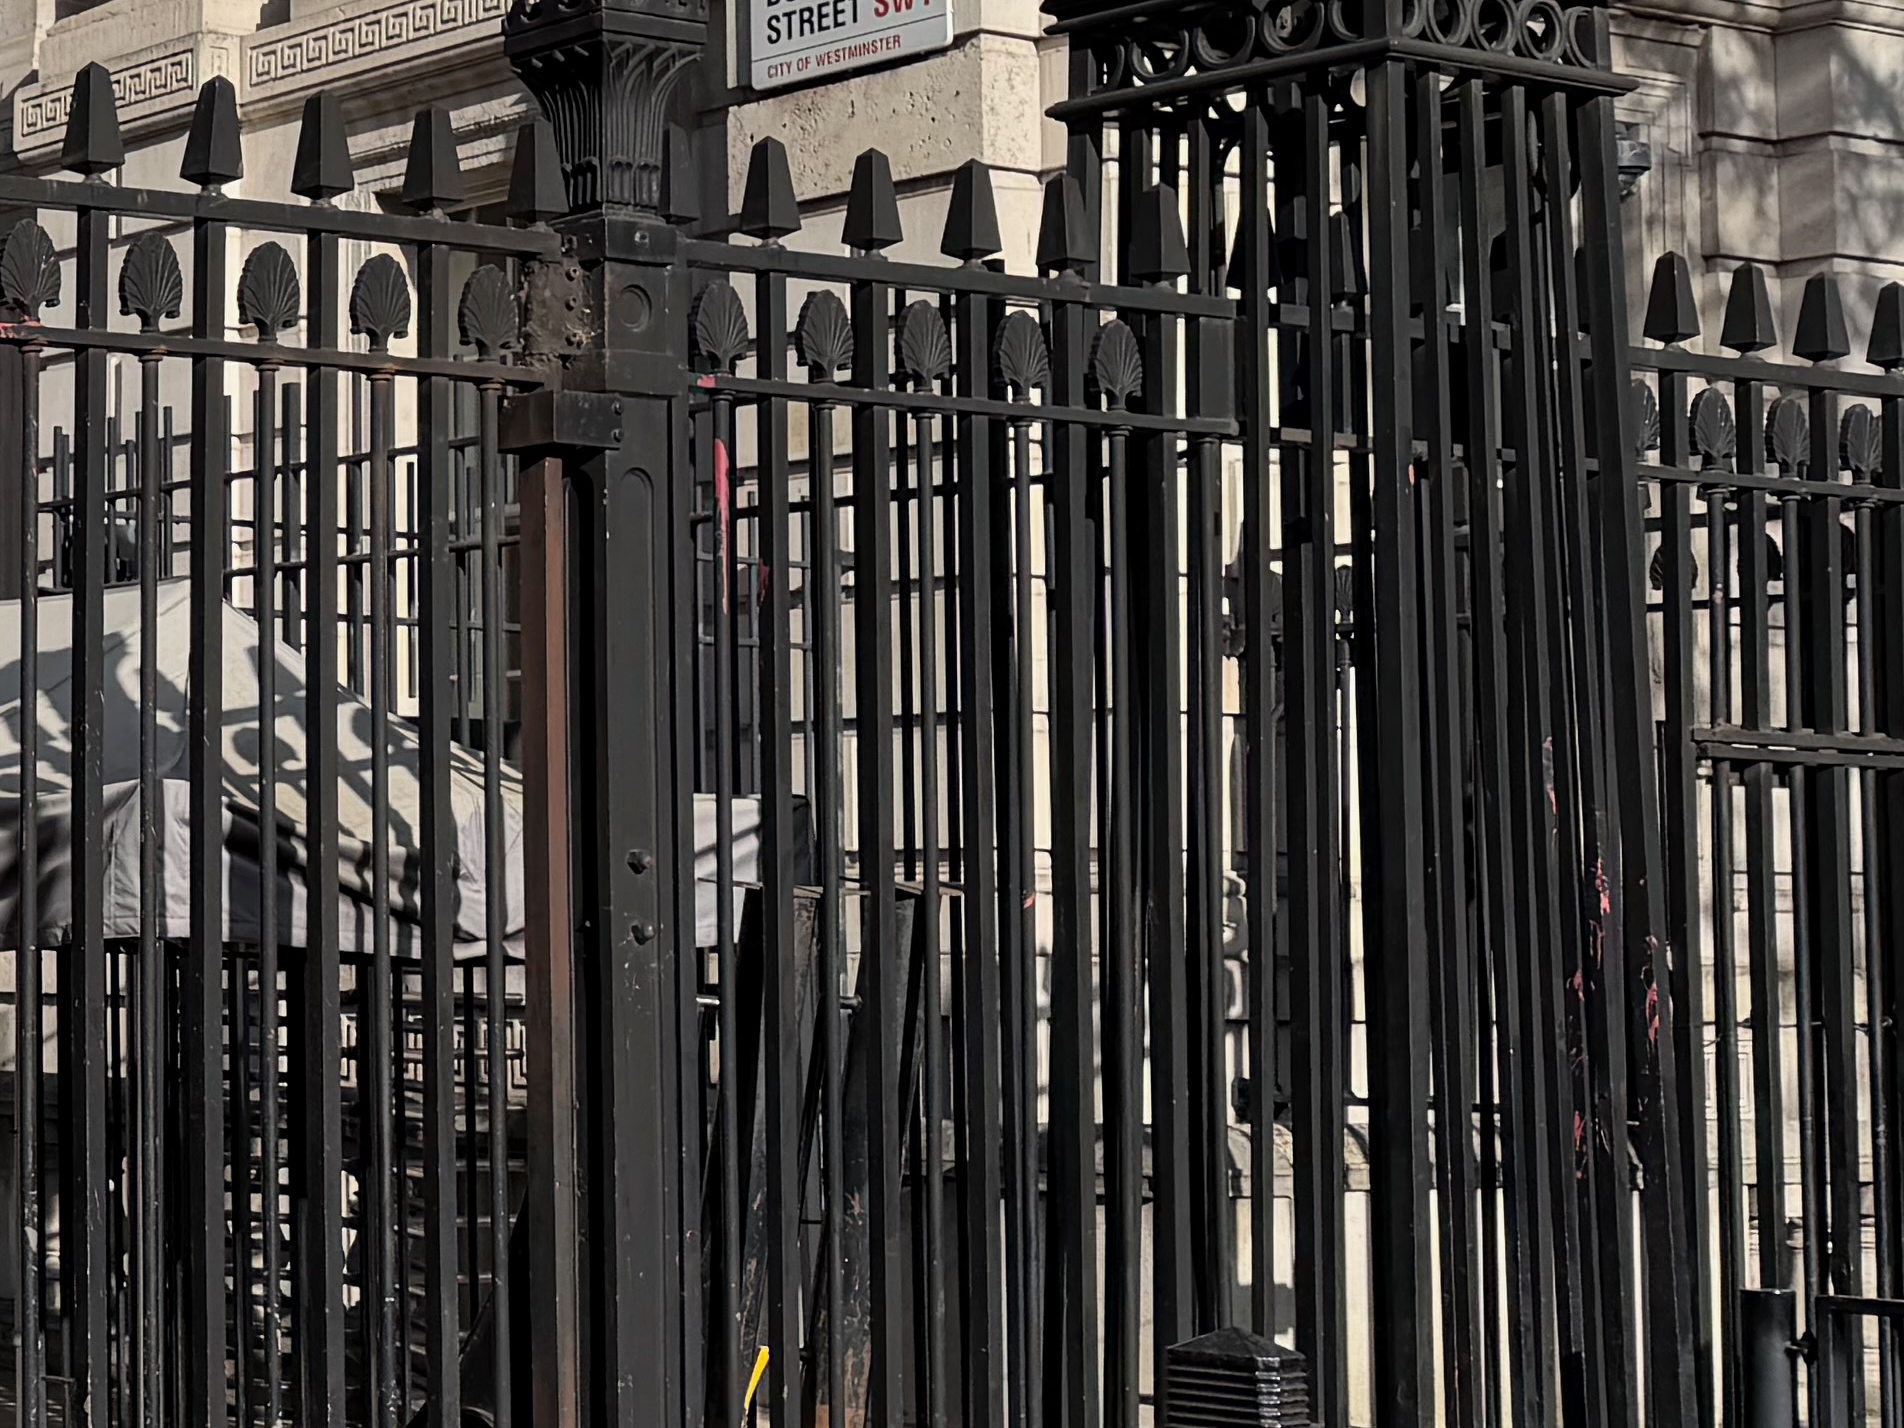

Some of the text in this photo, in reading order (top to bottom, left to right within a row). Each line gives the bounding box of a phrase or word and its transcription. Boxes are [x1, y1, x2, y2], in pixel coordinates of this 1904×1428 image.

[767, 34, 901, 79] CITY OF WESTMINSTER
